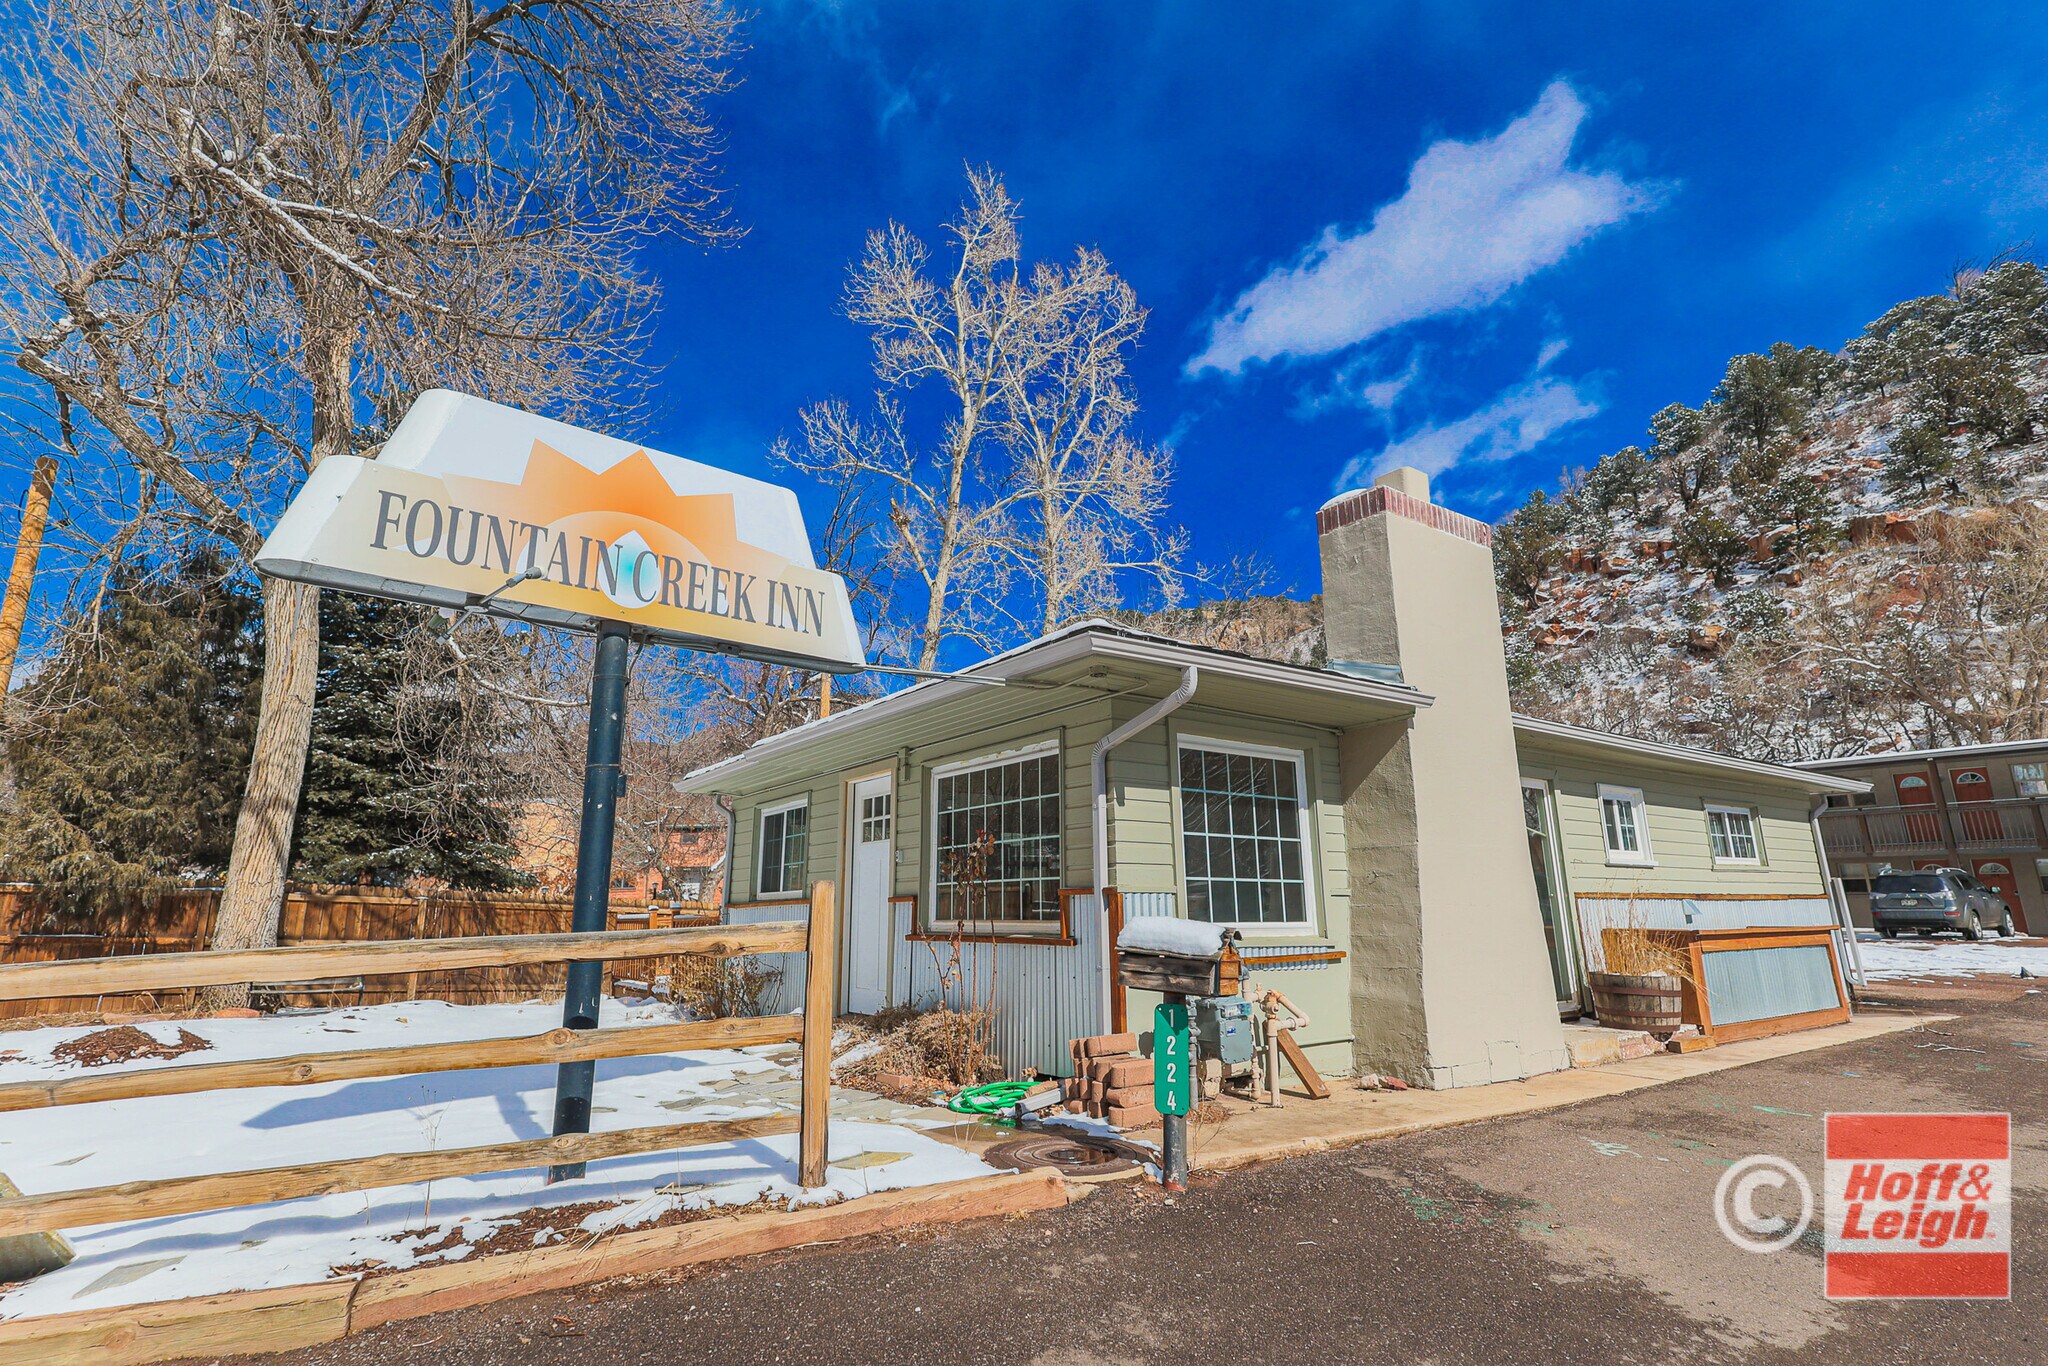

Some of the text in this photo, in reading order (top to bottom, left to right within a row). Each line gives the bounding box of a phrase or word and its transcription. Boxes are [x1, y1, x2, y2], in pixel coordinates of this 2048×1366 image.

[370, 490, 825, 637] FOUNTAIN CREEK INN
[1166, 1008, 1177, 1111] 1224
